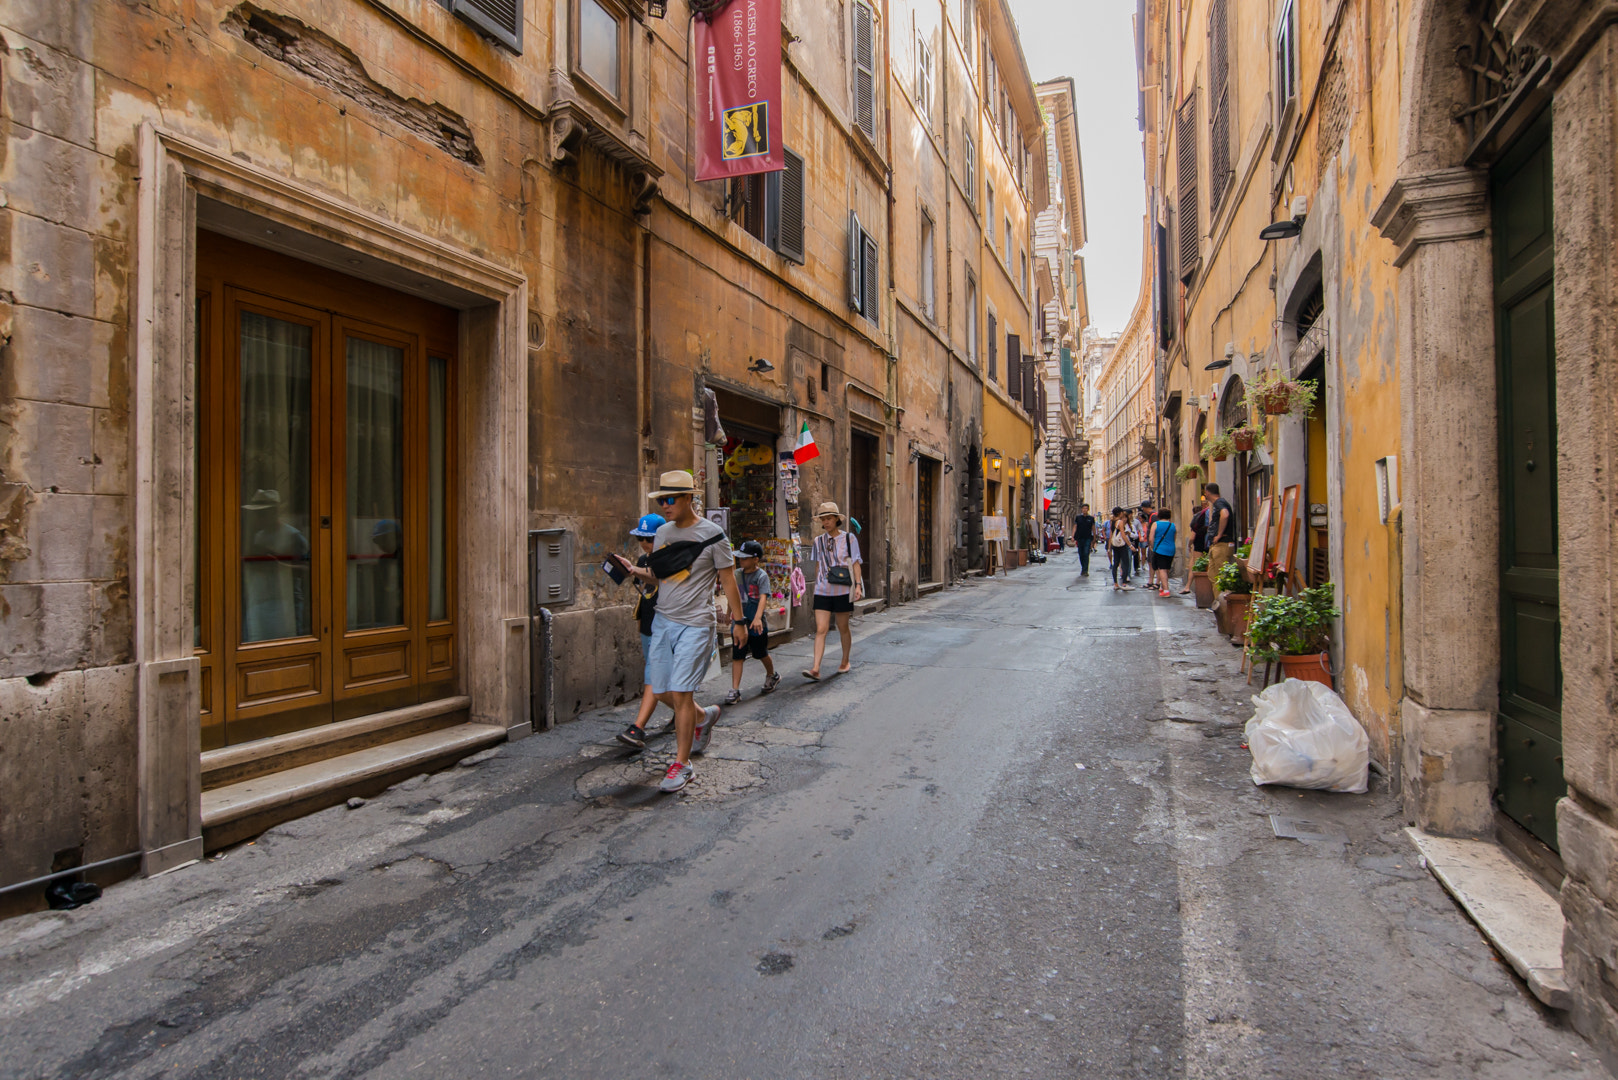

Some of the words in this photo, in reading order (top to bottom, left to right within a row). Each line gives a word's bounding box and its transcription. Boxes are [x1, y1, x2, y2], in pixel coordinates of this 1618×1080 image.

[733, 9, 743, 71] (1866-1963)
[747, 0, 757, 57] AGESILAO
[747, 58, 757, 98] GRECO
